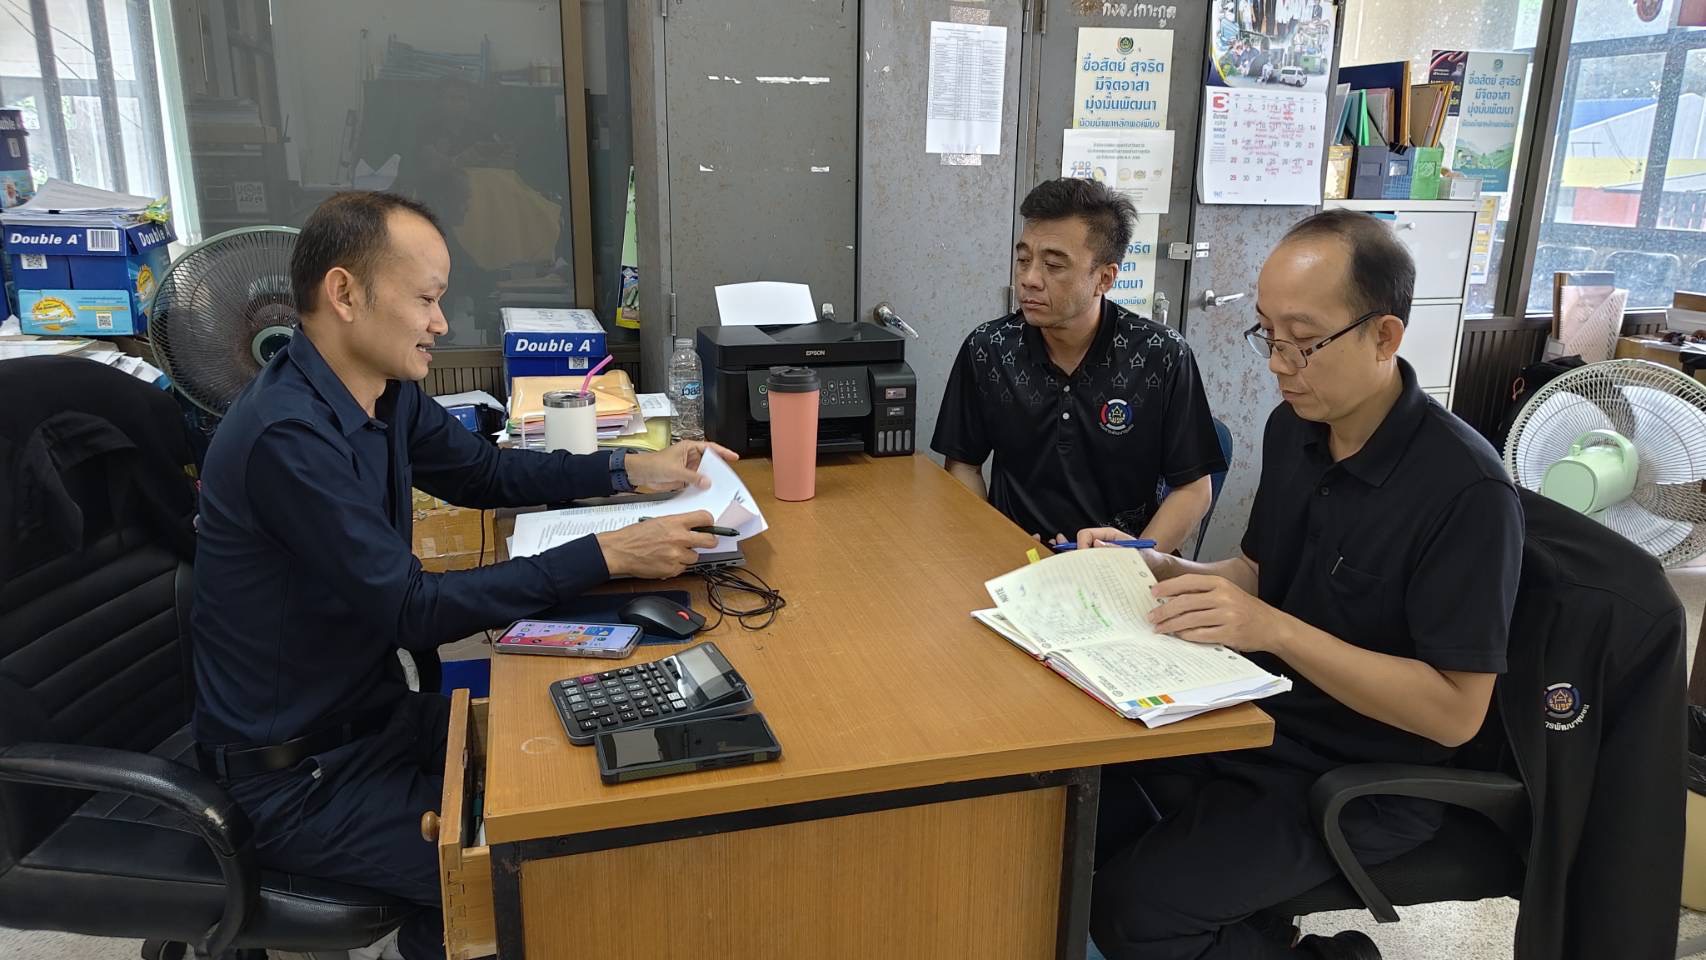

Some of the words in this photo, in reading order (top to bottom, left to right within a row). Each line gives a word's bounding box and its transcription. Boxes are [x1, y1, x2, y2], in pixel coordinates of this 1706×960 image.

[1130, 59, 1165, 76] สุจริต
[1095, 76, 1150, 91] มีจิตอาสา
[1085, 92, 1157, 114] มุ่งมั่นพัฒนา
[10, 233, 62, 245] Double
[66, 234, 78, 245] A
[137, 227, 166, 247] Double
[1128, 242, 1151, 254] จริต
[515, 338, 574, 352] Double
[578, 339, 591, 352] A
